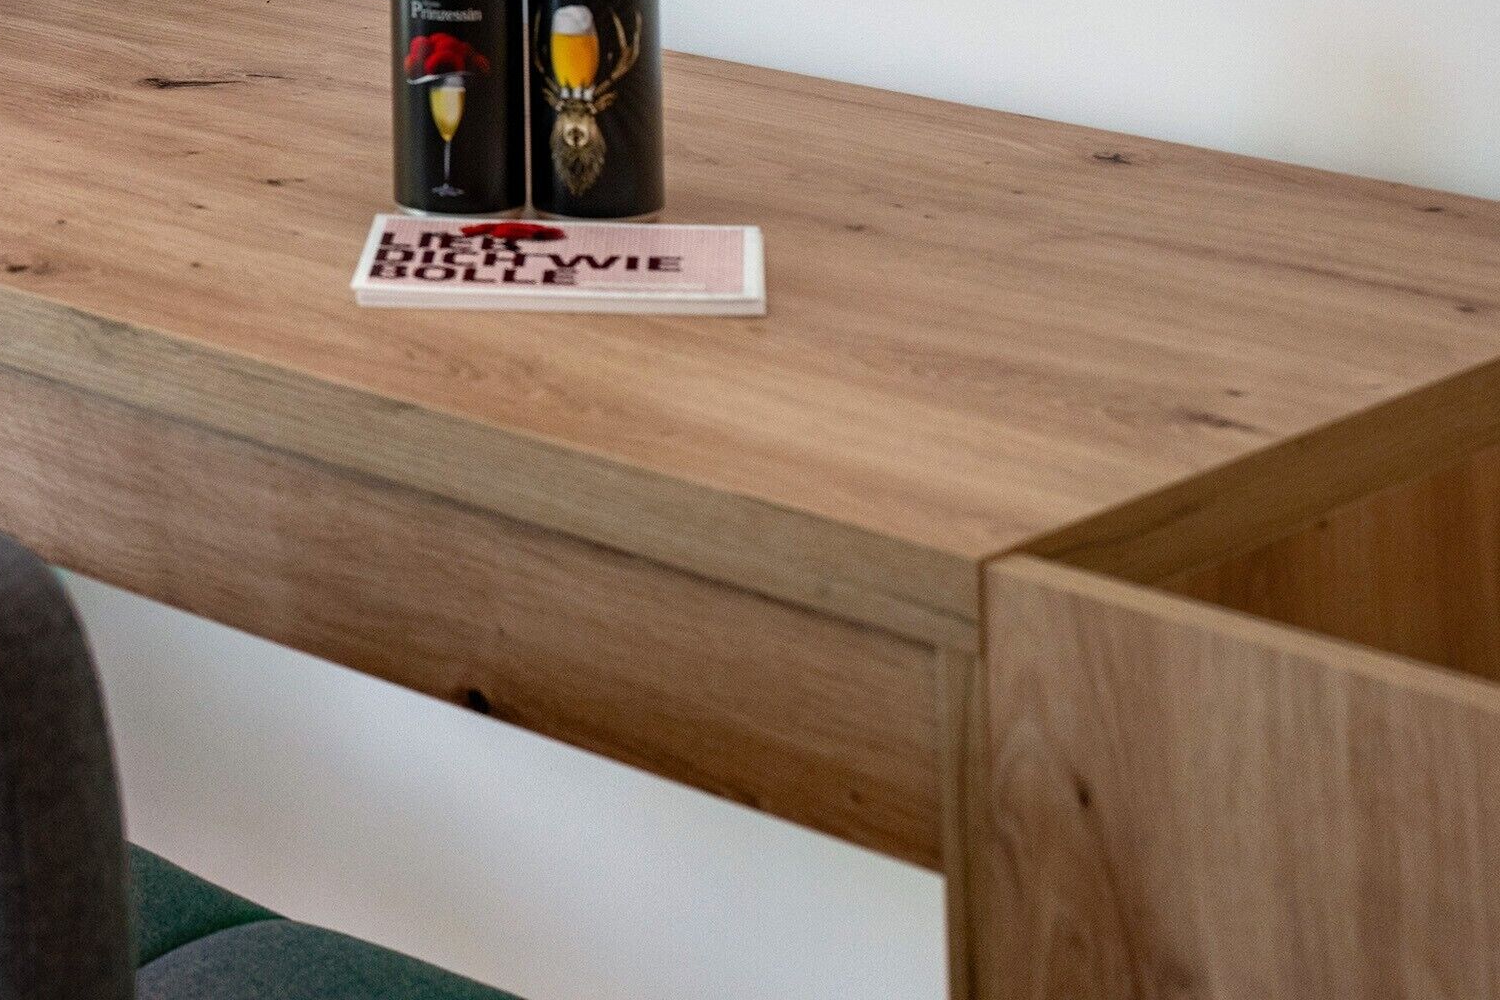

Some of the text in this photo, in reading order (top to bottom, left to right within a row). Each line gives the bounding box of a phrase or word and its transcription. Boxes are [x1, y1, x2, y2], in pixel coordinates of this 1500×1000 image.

[410, 0, 483, 22] Prinzessin
[373, 248, 685, 272] DICH WIE
[369, 264, 578, 285] BOLLE
